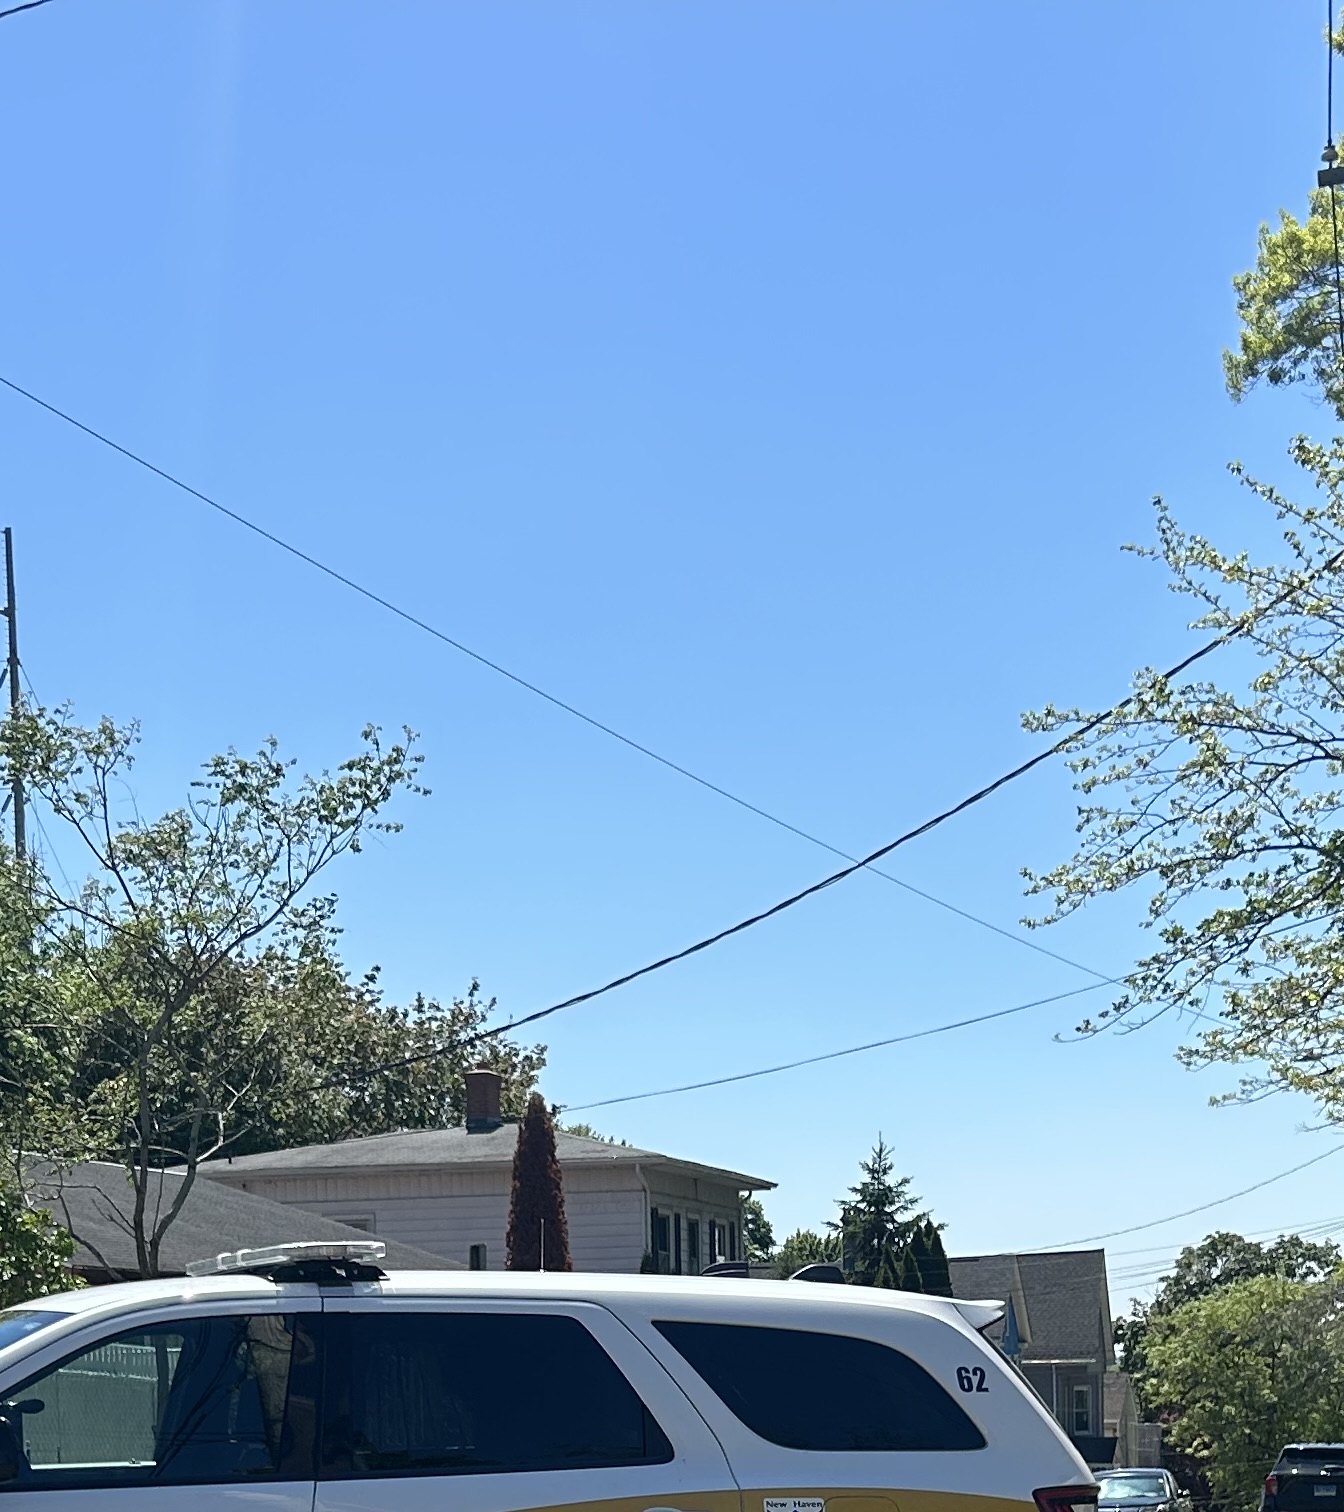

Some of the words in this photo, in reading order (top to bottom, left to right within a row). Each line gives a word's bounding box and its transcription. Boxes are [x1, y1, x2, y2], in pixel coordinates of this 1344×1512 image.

[956, 1366, 990, 1393] 62
[766, 1500, 788, 1508] New
[793, 1500, 823, 1508] Haven
